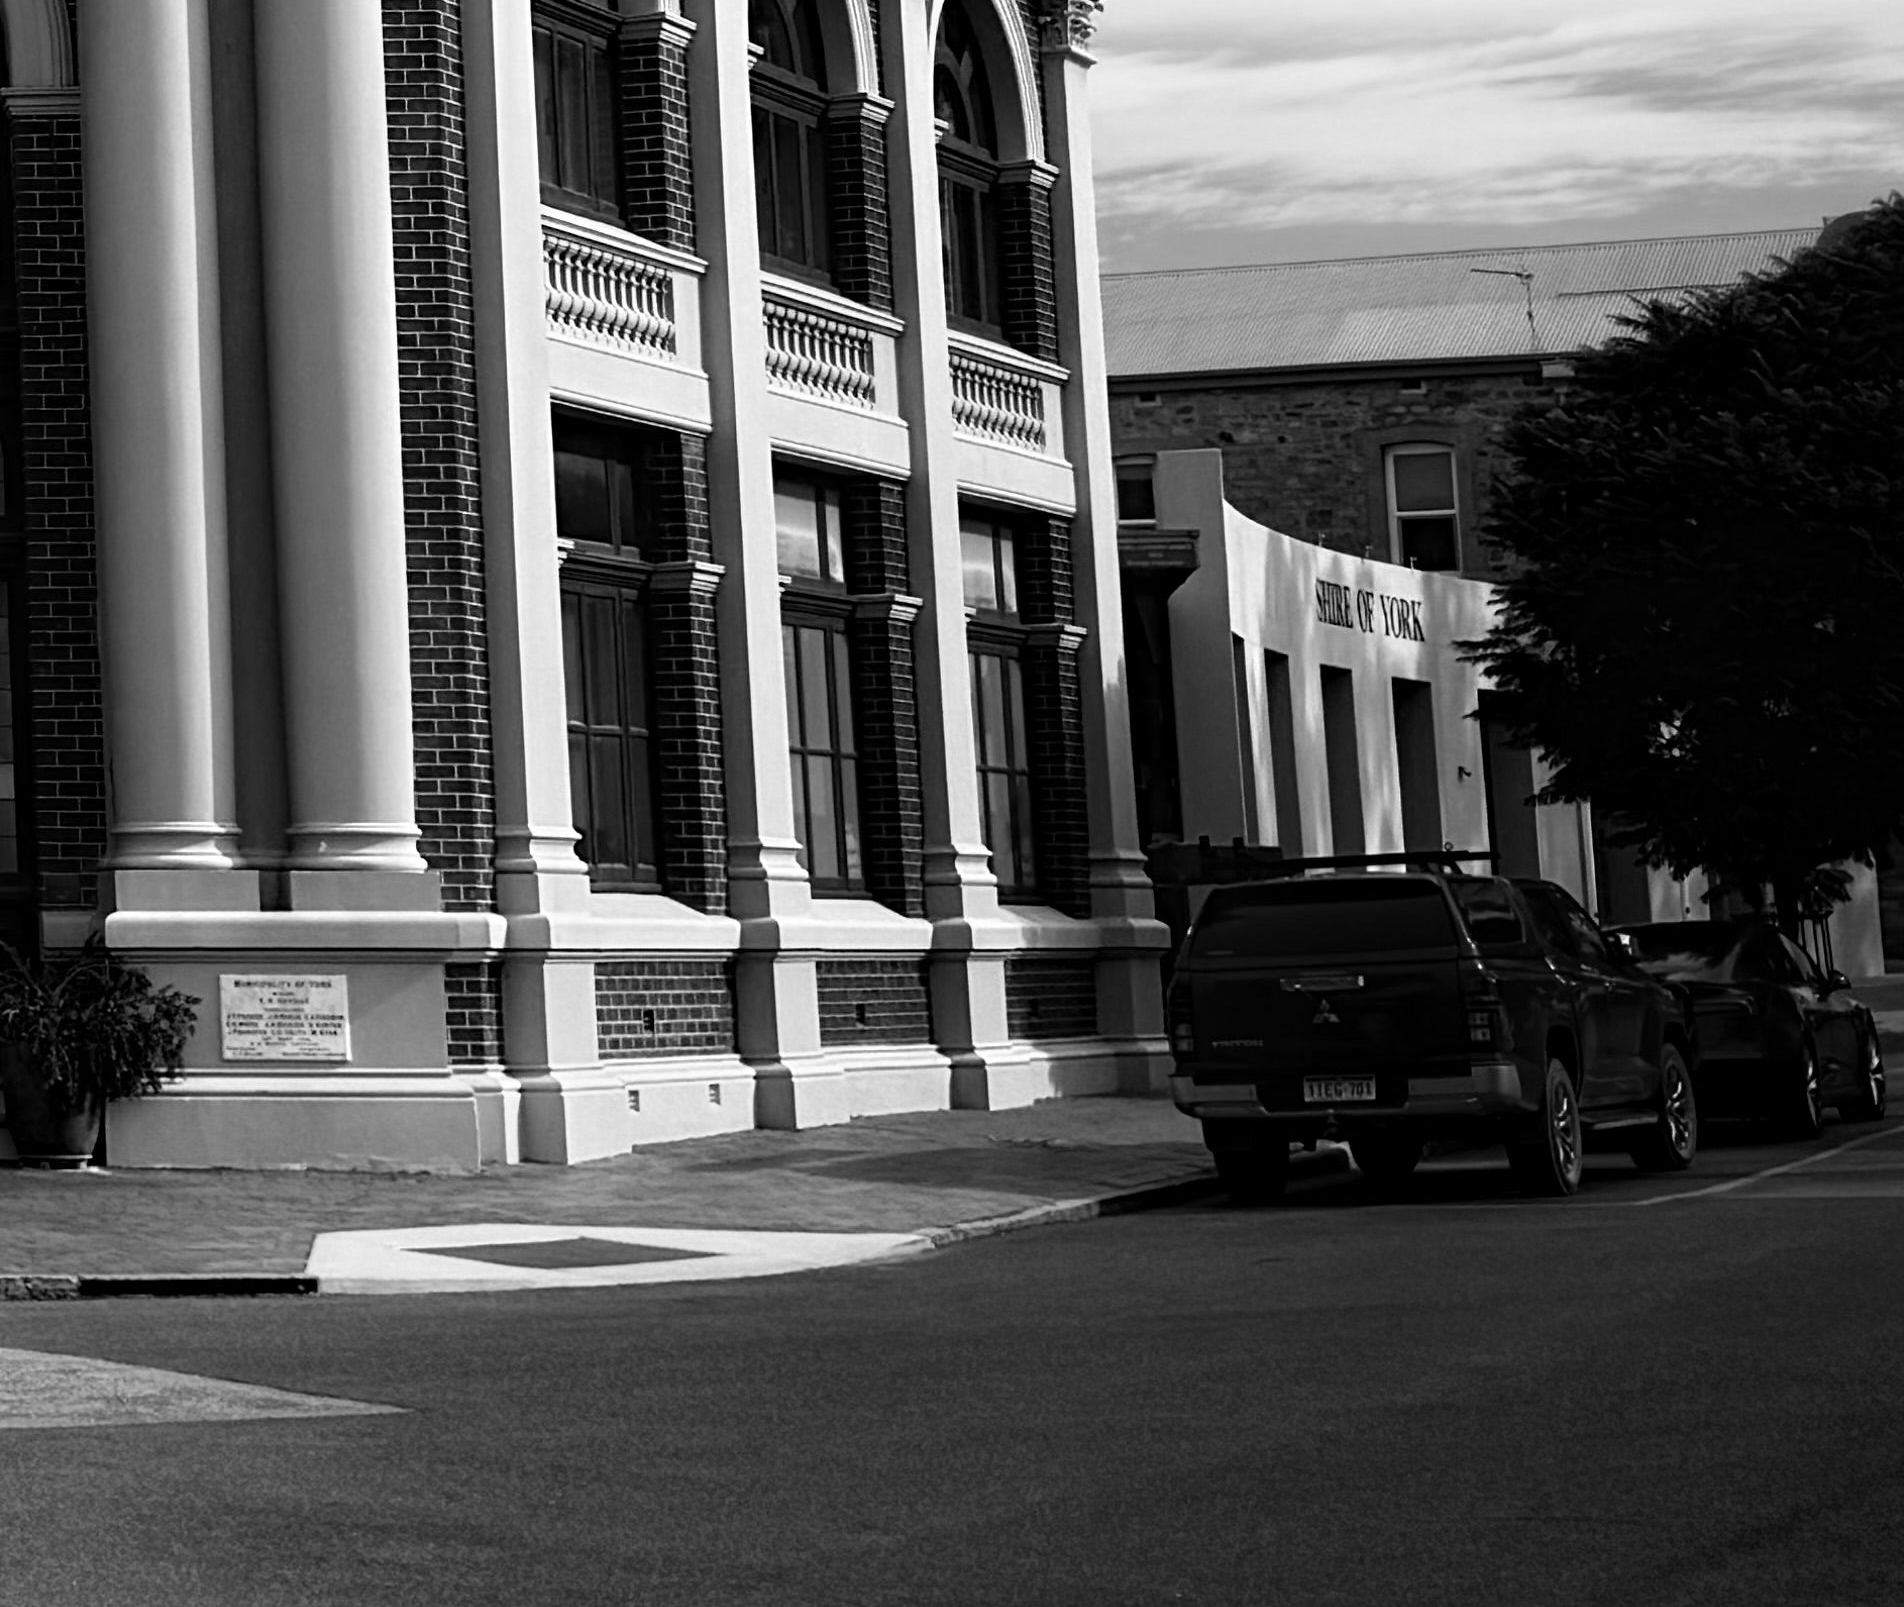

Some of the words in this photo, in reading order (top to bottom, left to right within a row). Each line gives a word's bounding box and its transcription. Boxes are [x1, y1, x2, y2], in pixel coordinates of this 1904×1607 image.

[1315, 577, 1354, 629] SHIRE
[1356, 588, 1375, 633] OF
[1379, 594, 1425, 642] YORK
